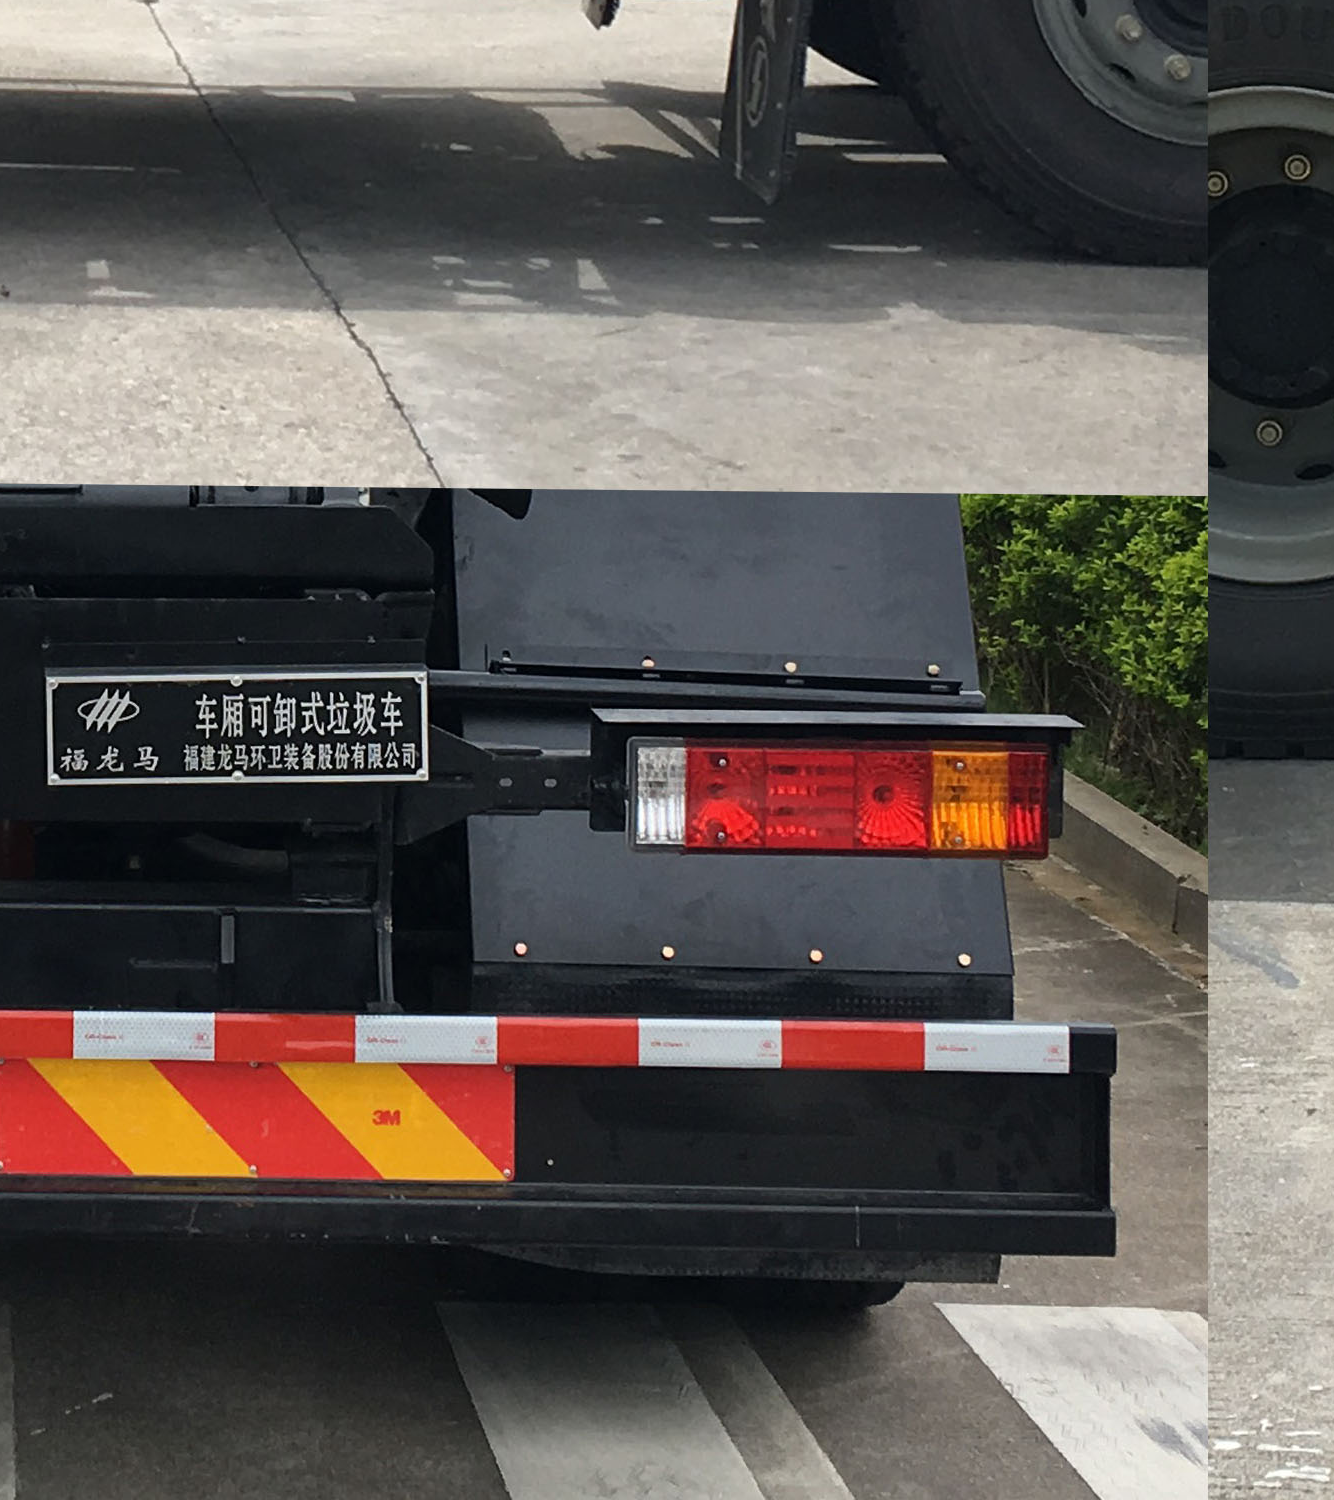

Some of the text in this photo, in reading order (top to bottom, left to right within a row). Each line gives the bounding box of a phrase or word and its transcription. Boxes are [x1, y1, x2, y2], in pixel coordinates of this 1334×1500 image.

[195, 691, 404, 739] 车厢可卸式垃圾车
[60, 746, 159, 772] 福龙马
[183, 741, 417, 772] 福建龙马环卫装备股份有限公司
[372, 1109, 401, 1126] 3M
